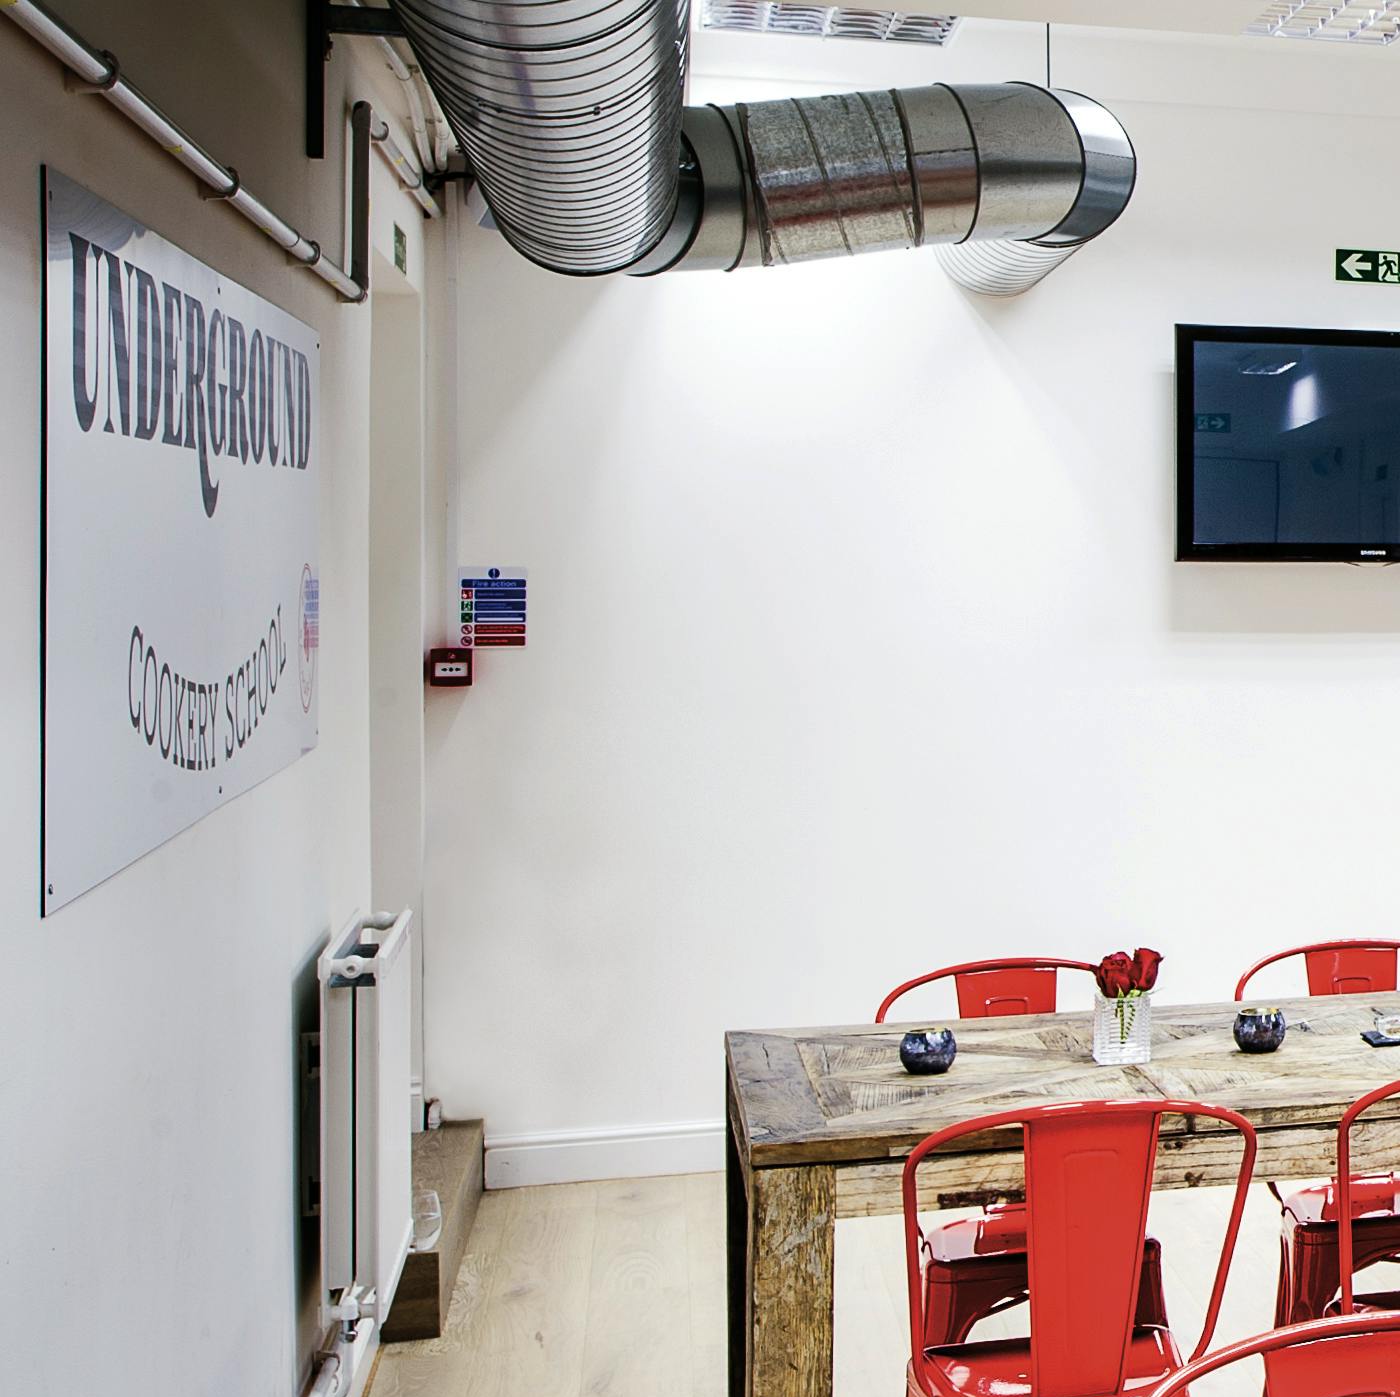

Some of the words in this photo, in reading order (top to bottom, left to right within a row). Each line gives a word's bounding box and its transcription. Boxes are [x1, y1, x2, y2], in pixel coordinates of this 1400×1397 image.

[69, 230, 312, 519] UNDERGROUND
[128, 624, 218, 772] COOKERY
[225, 602, 287, 763] SCHOOL
